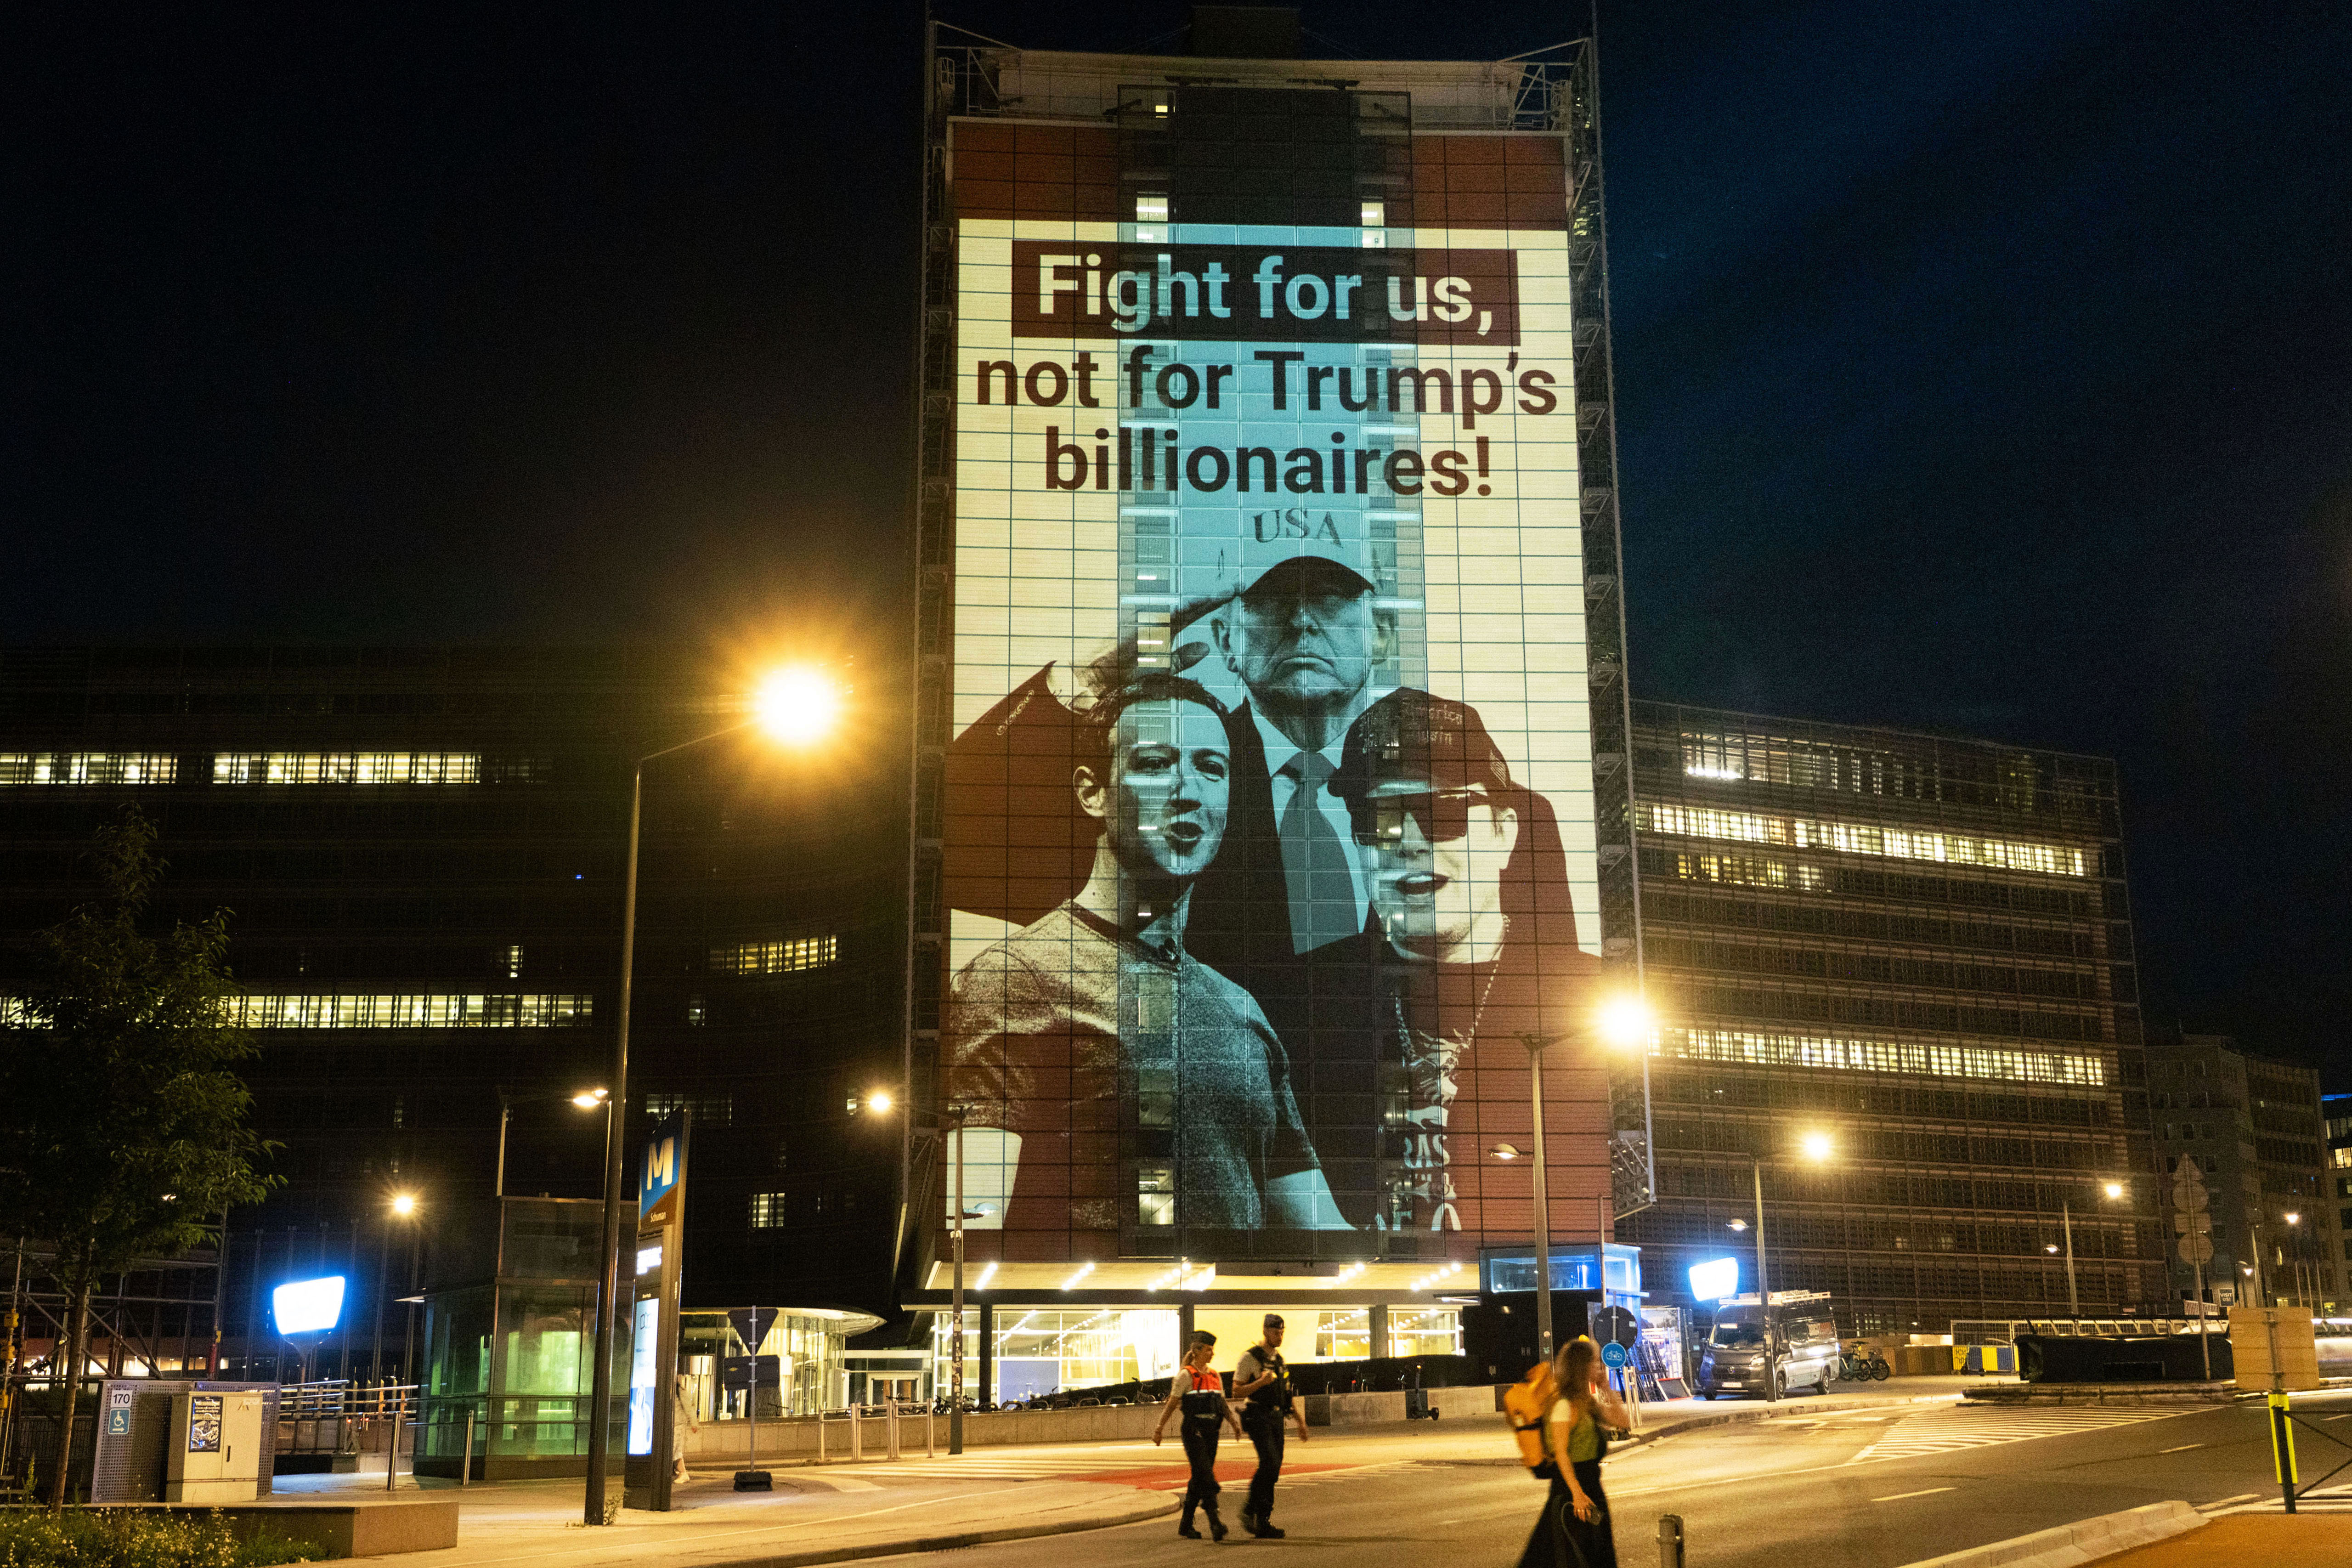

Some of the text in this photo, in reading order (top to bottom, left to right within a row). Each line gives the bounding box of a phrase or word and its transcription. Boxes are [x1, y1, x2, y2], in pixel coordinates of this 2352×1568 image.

[1039, 252, 1493, 336] Fight for us,
[977, 345, 1557, 430] not for Trump’s
[1046, 426, 1493, 497] billionaires!
[1253, 508, 1343, 549] USA
[647, 1136, 674, 1190] M
[113, 1394, 130, 1404] 170
